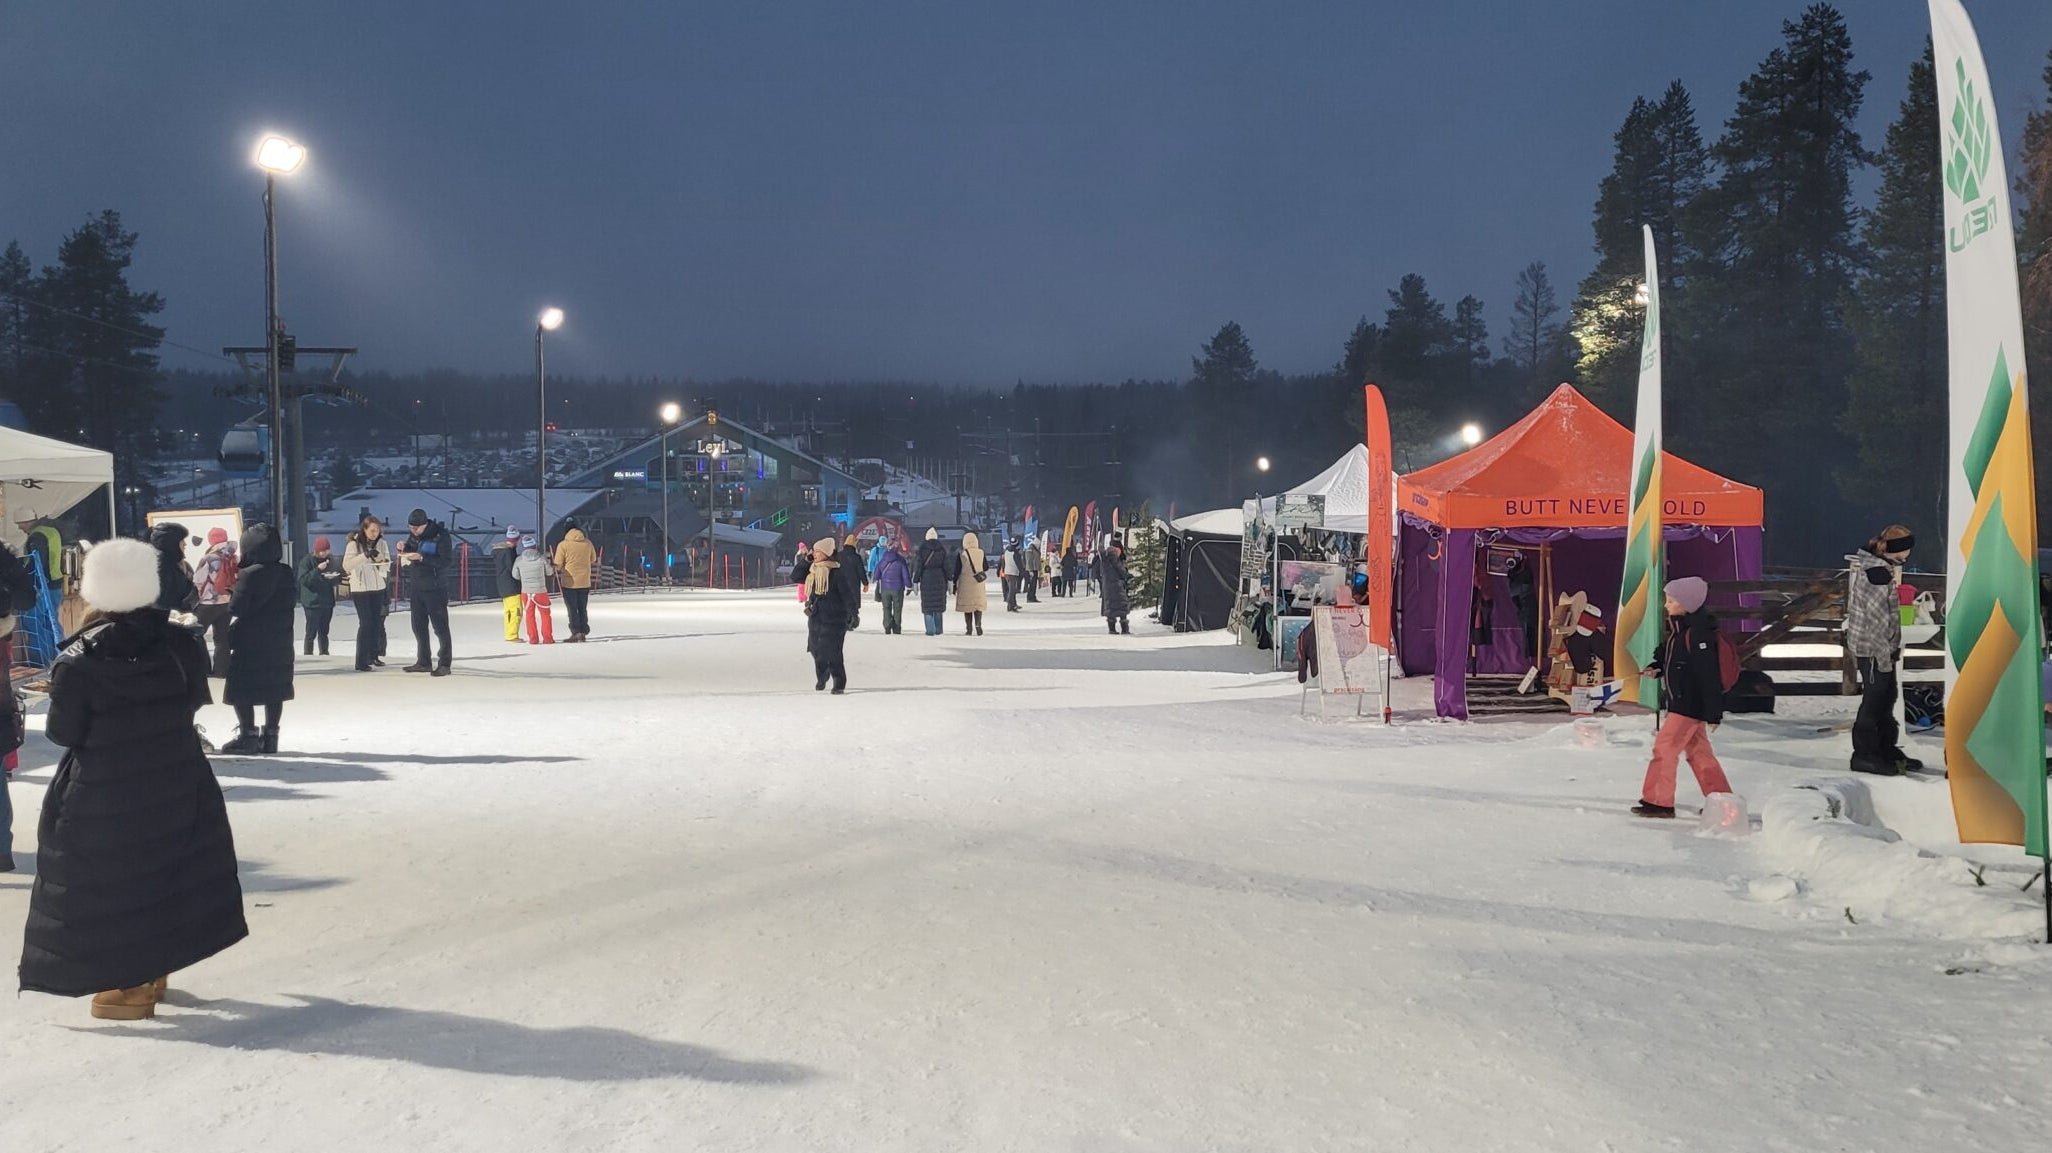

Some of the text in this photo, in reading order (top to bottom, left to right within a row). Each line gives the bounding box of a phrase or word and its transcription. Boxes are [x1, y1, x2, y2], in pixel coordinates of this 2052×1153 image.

[1506, 499, 1706, 516] BUTT NEVE OLD
